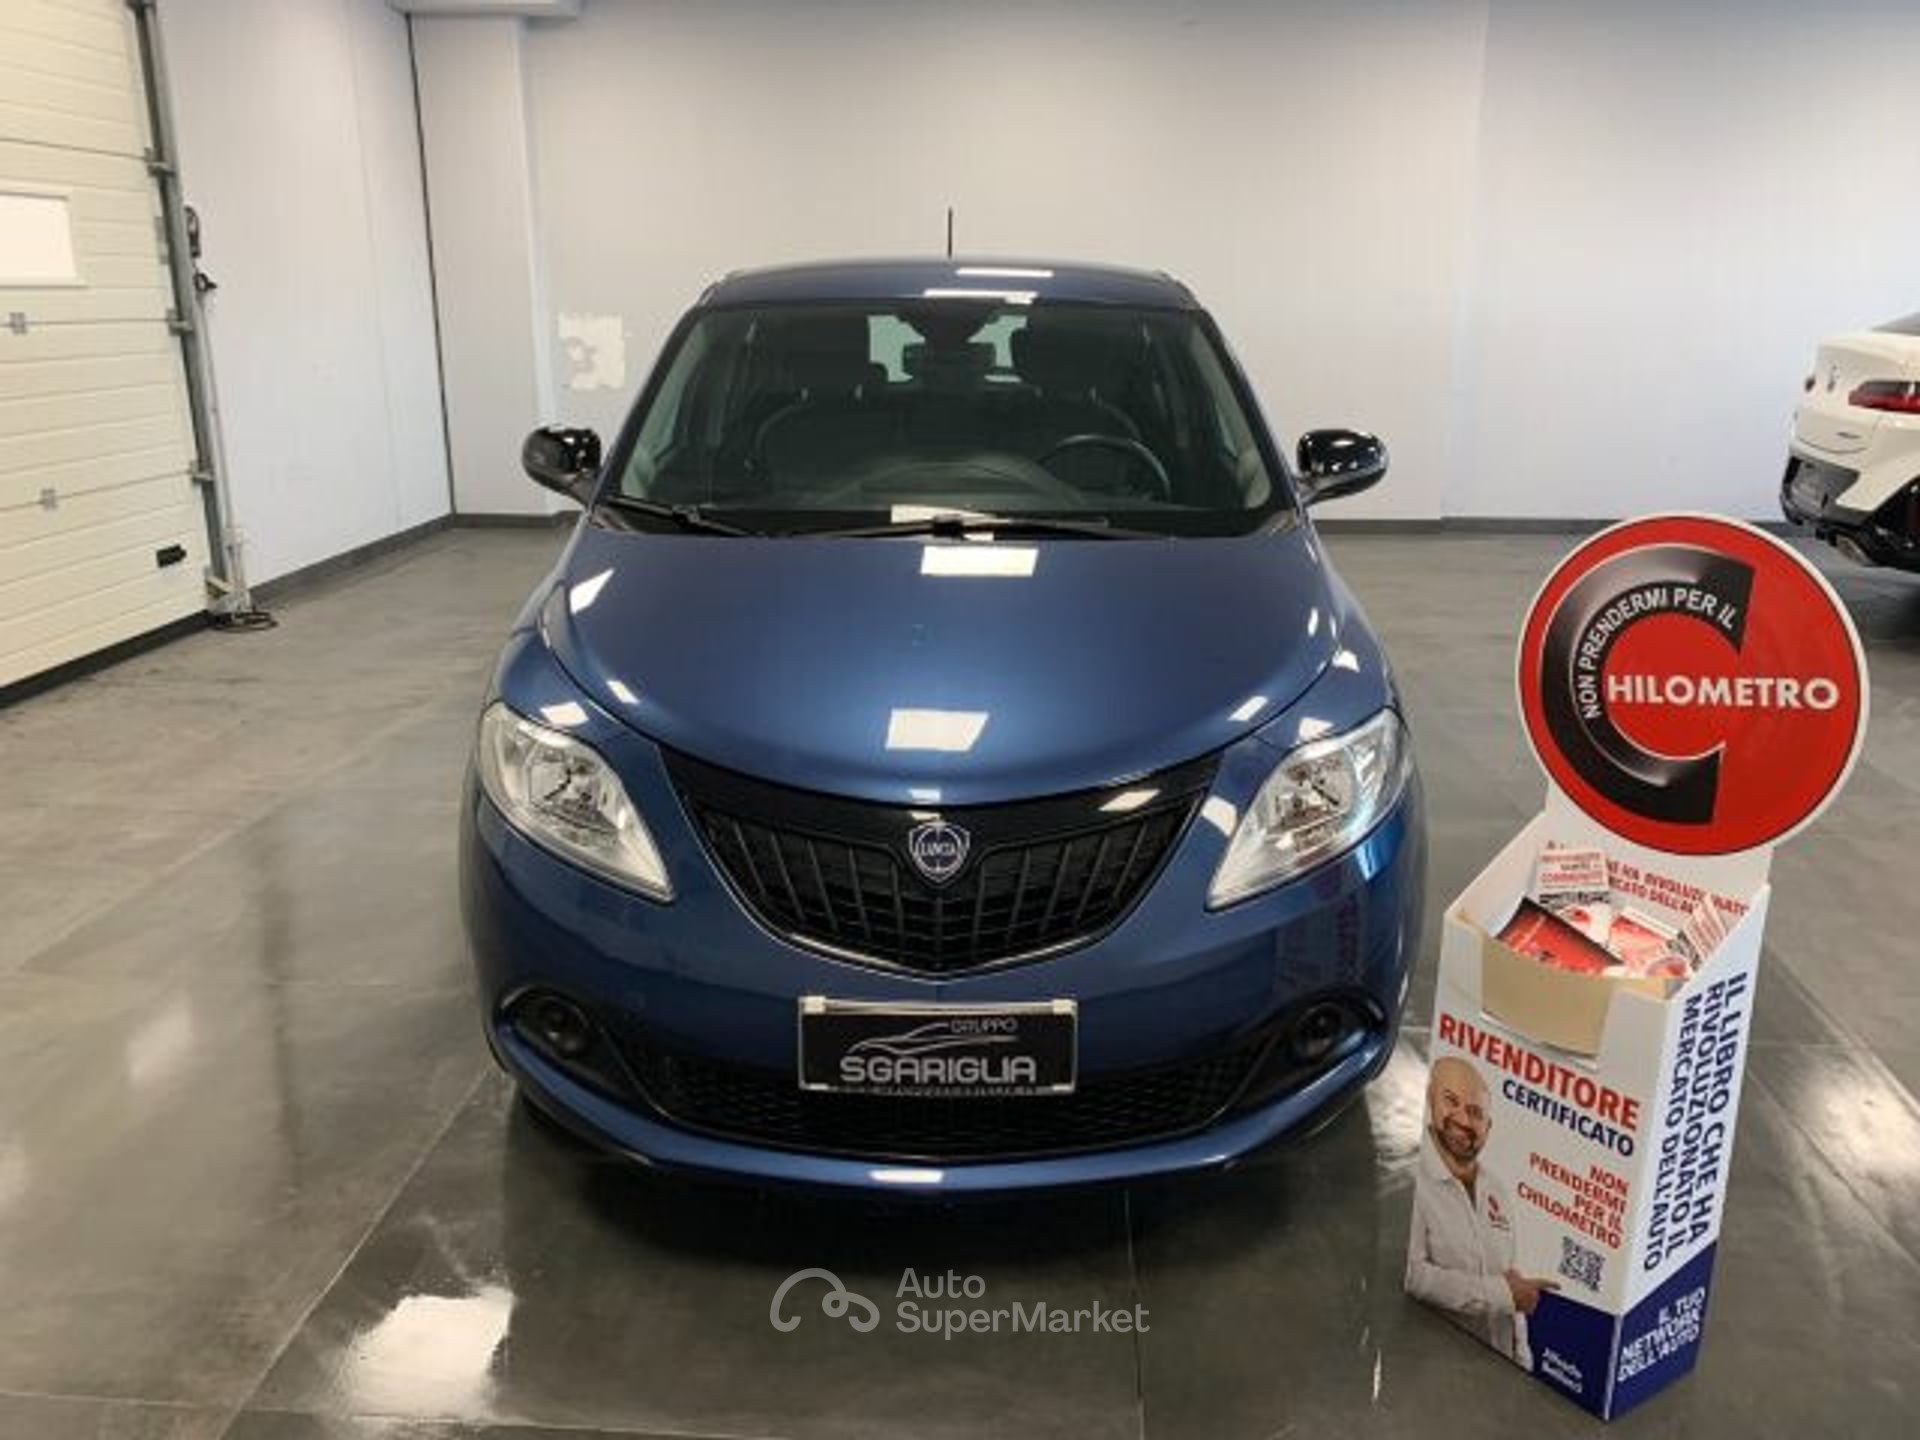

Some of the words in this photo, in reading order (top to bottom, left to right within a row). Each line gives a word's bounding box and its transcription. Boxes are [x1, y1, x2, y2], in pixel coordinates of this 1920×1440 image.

[1578, 588, 1669, 671] PRENDERMI
[1673, 587, 1718, 617] PER
[1718, 604, 1737, 630] IL
[1577, 674, 1601, 720] NON
[1724, 971, 1748, 1009] IL
[840, 1056, 1037, 1085] SGARIGLIA
[1438, 1013, 1641, 1133] RIVENDITORE
[1665, 993, 1703, 1128] MERCATO
[1708, 1010, 1742, 1114] LIBRO
[1501, 1079, 1635, 1157] CERTIFICATO
[1671, 980, 1726, 1225] RIVOLUZIONATO
[1529, 1152, 1627, 1215] PRENDERMI
[1590, 1164, 1630, 1197] NON
[1695, 1121, 1726, 1190] CHE
[1517, 1181, 1622, 1250] CHILOMETRO
[1574, 1194, 1605, 1220] PER
[1607, 1212, 1624, 1234] IL
[1644, 1133, 1680, 1272] DELL'AUTO
[1688, 1193, 1714, 1244] HA
[1665, 1228, 1688, 1259] IL
